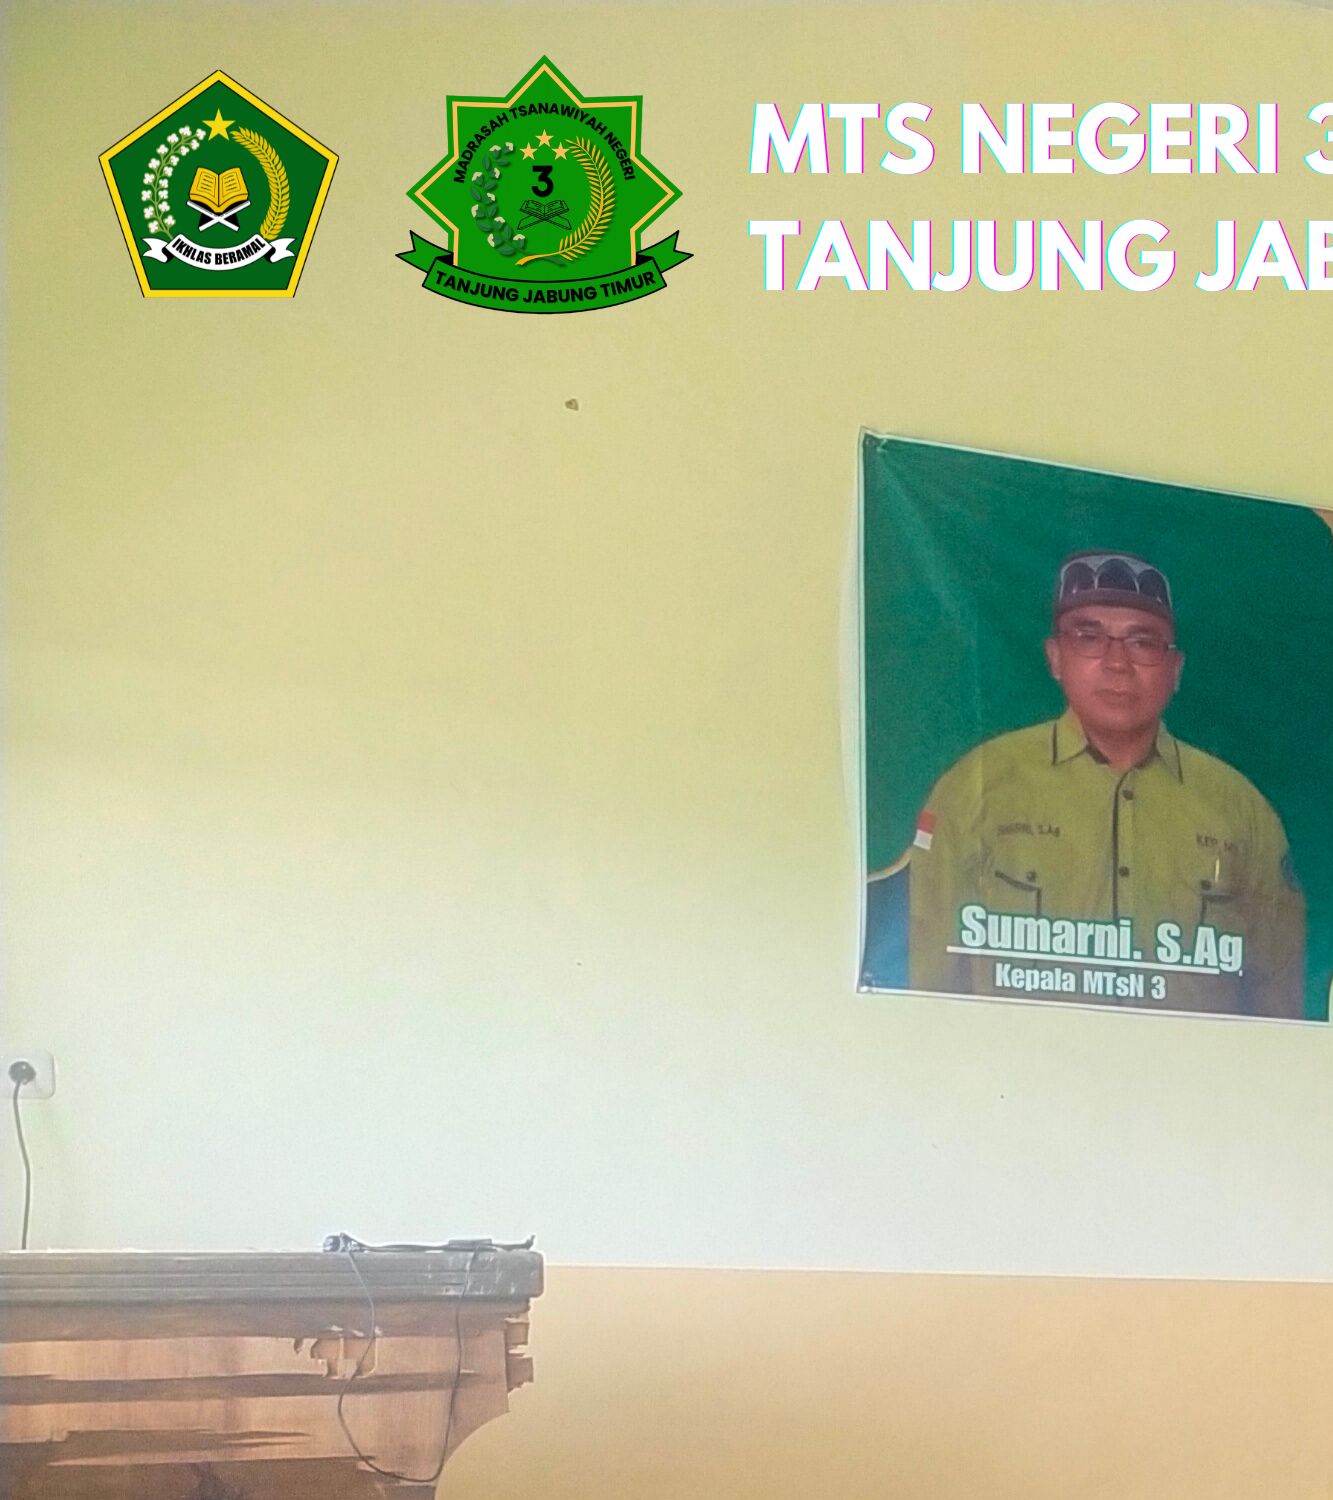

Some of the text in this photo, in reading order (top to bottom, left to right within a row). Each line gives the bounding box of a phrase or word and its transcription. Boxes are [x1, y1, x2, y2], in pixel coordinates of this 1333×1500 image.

[961, 904, 1244, 974] Sumarni. S.Ag
[994, 962, 1167, 1000] Kepala MTsN 3
